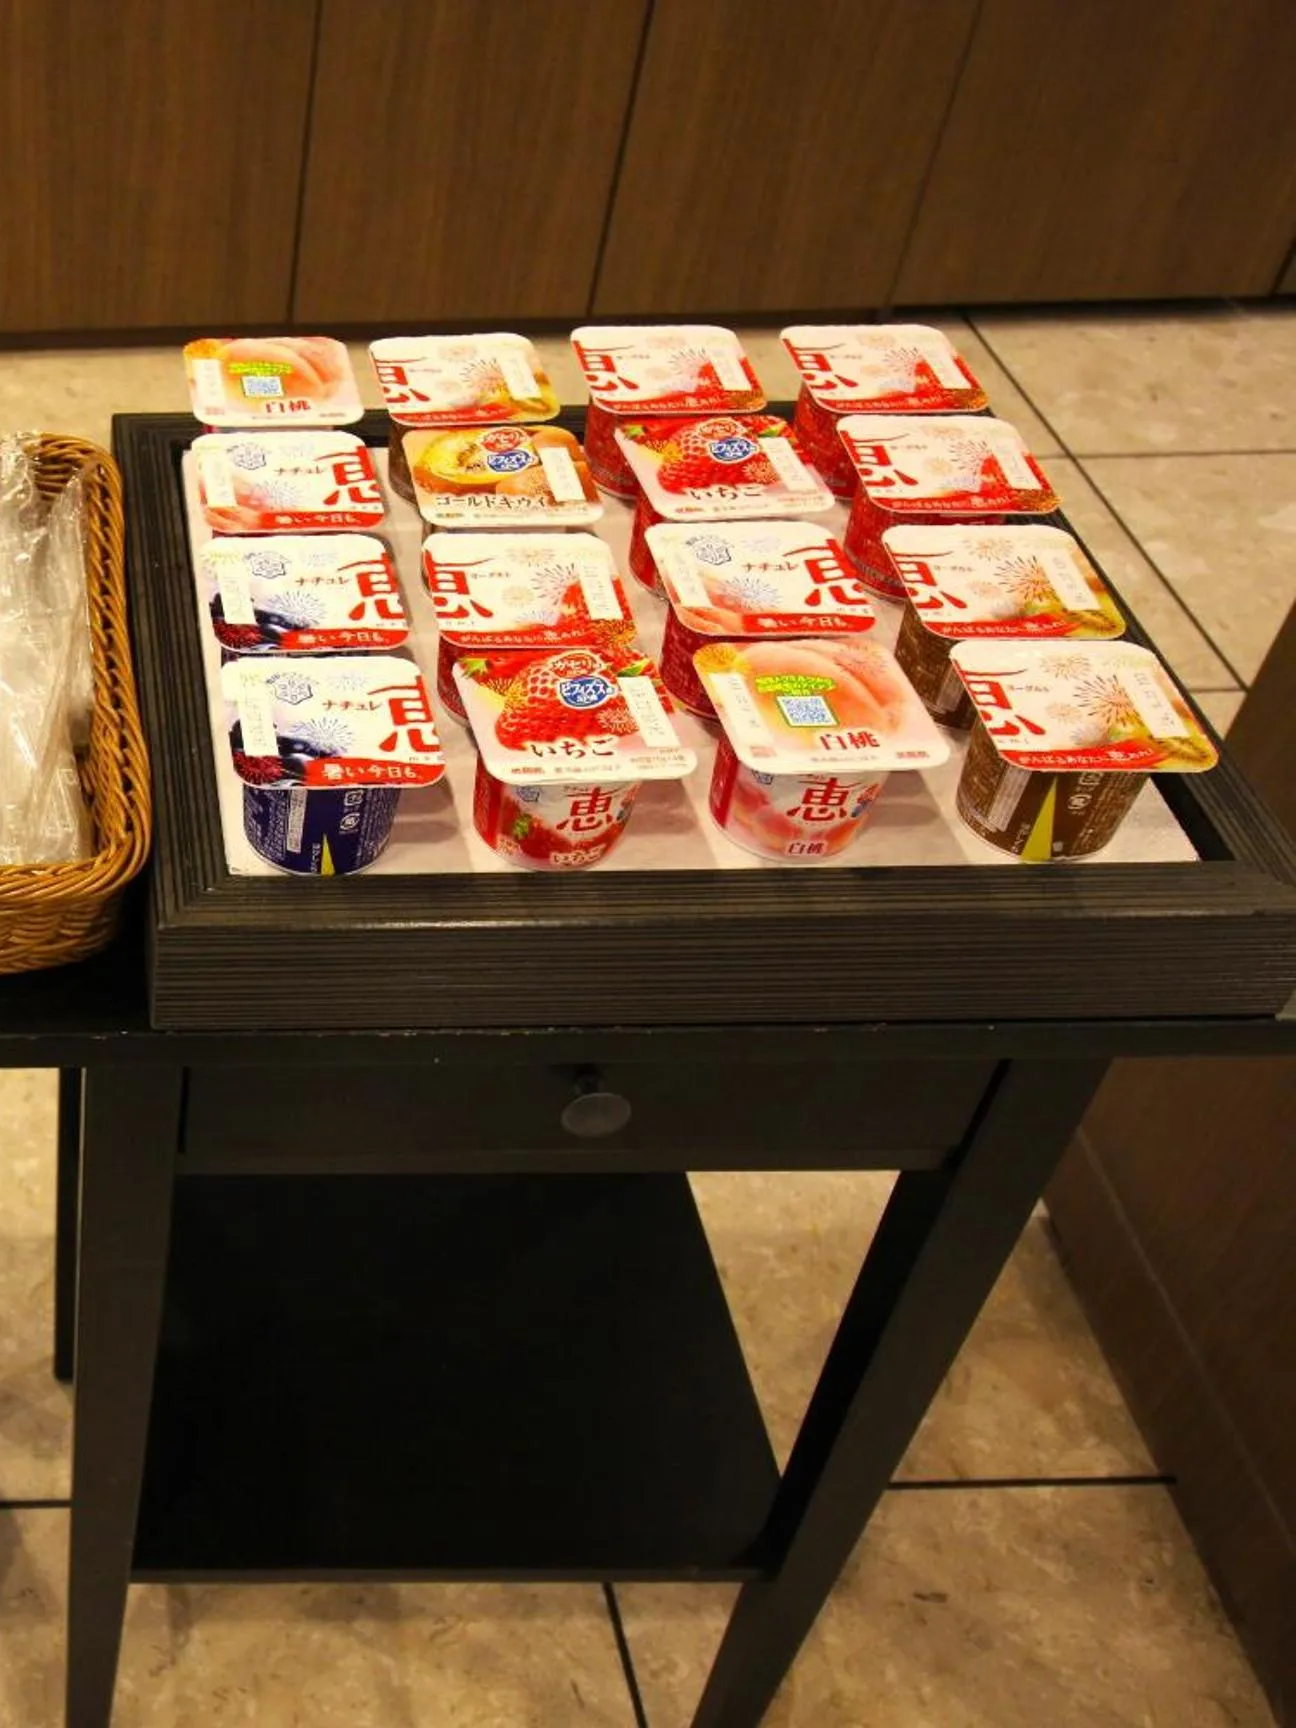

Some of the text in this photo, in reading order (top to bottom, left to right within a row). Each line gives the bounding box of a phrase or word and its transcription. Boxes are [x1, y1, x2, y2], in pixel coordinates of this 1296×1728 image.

[436, 495, 547, 509] ゴールドキウイ
[689, 486, 763, 500] いちご
[322, 700, 383, 711] ナチュレ
[531, 737, 615, 758] いちご
[819, 731, 880, 750] 白桃
[786, 777, 861, 821] 恵
[556, 787, 619, 832] 恵
